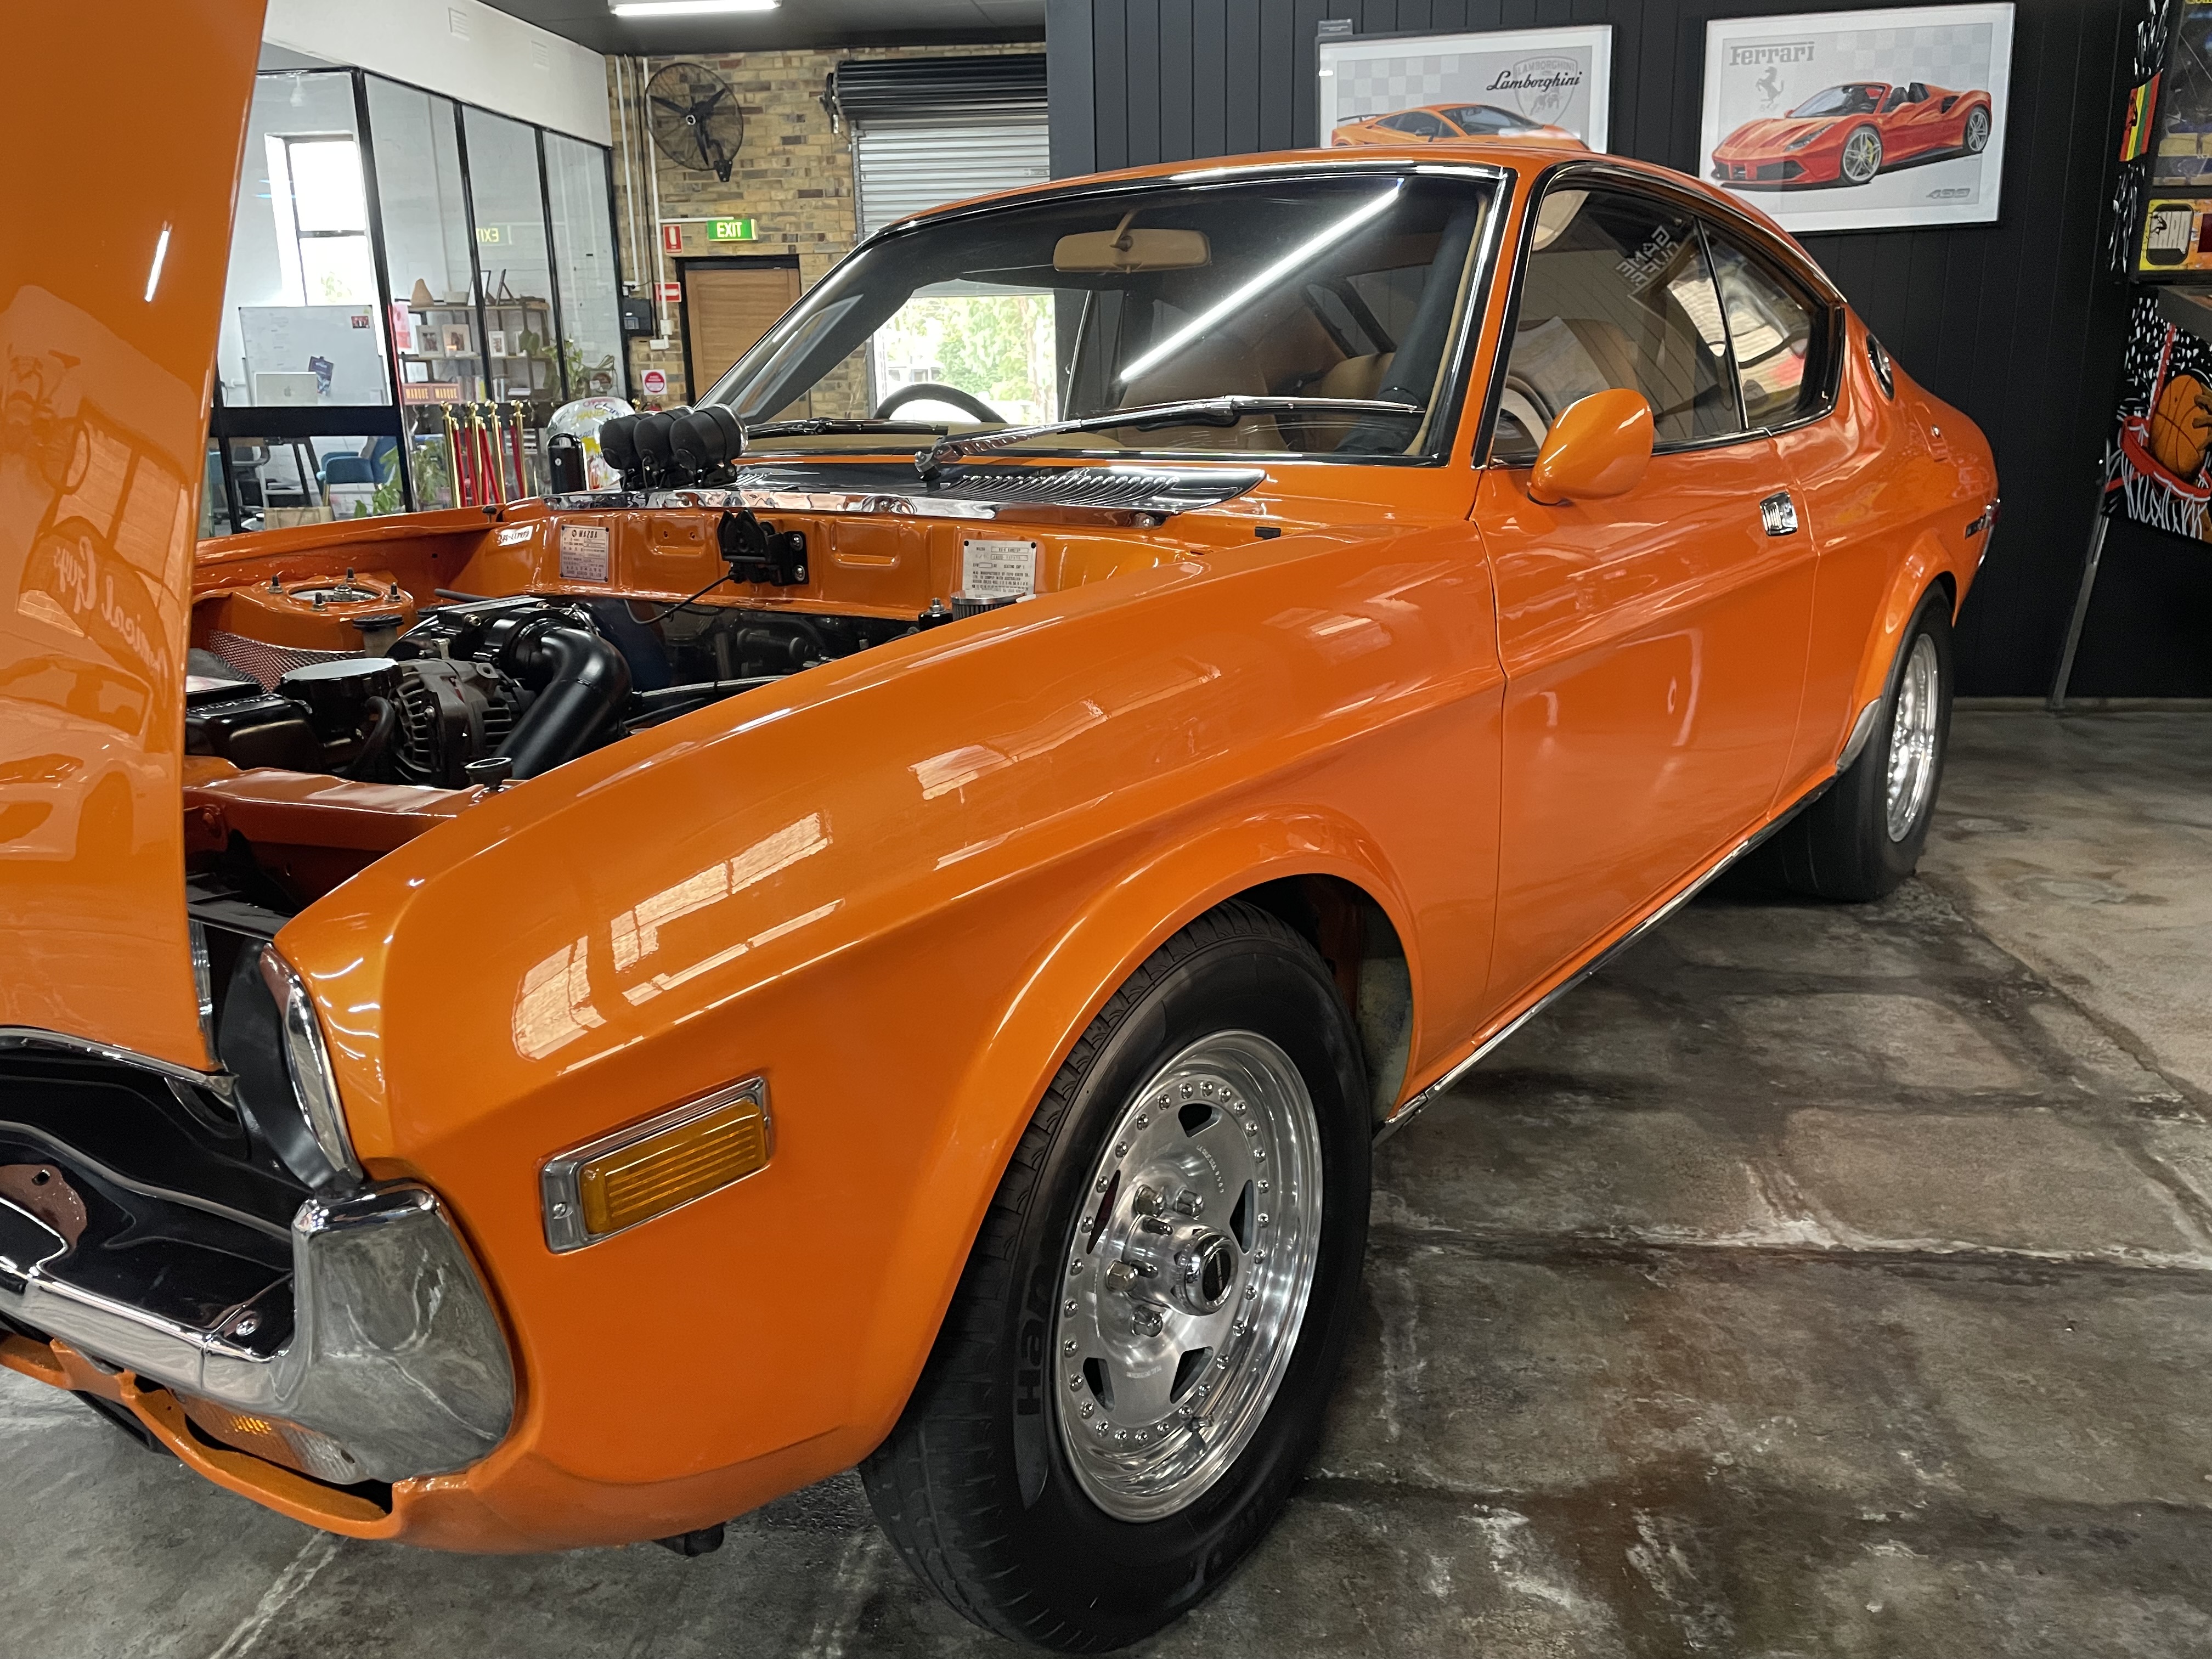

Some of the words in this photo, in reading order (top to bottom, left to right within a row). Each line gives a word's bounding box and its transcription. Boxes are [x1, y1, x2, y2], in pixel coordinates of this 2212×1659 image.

[1729, 41, 1815, 66] Ferrari
[1486, 66, 1582, 92] Lamborghini
[716, 222, 742, 238] EXIT
[579, 530, 597, 538] MAZDA
